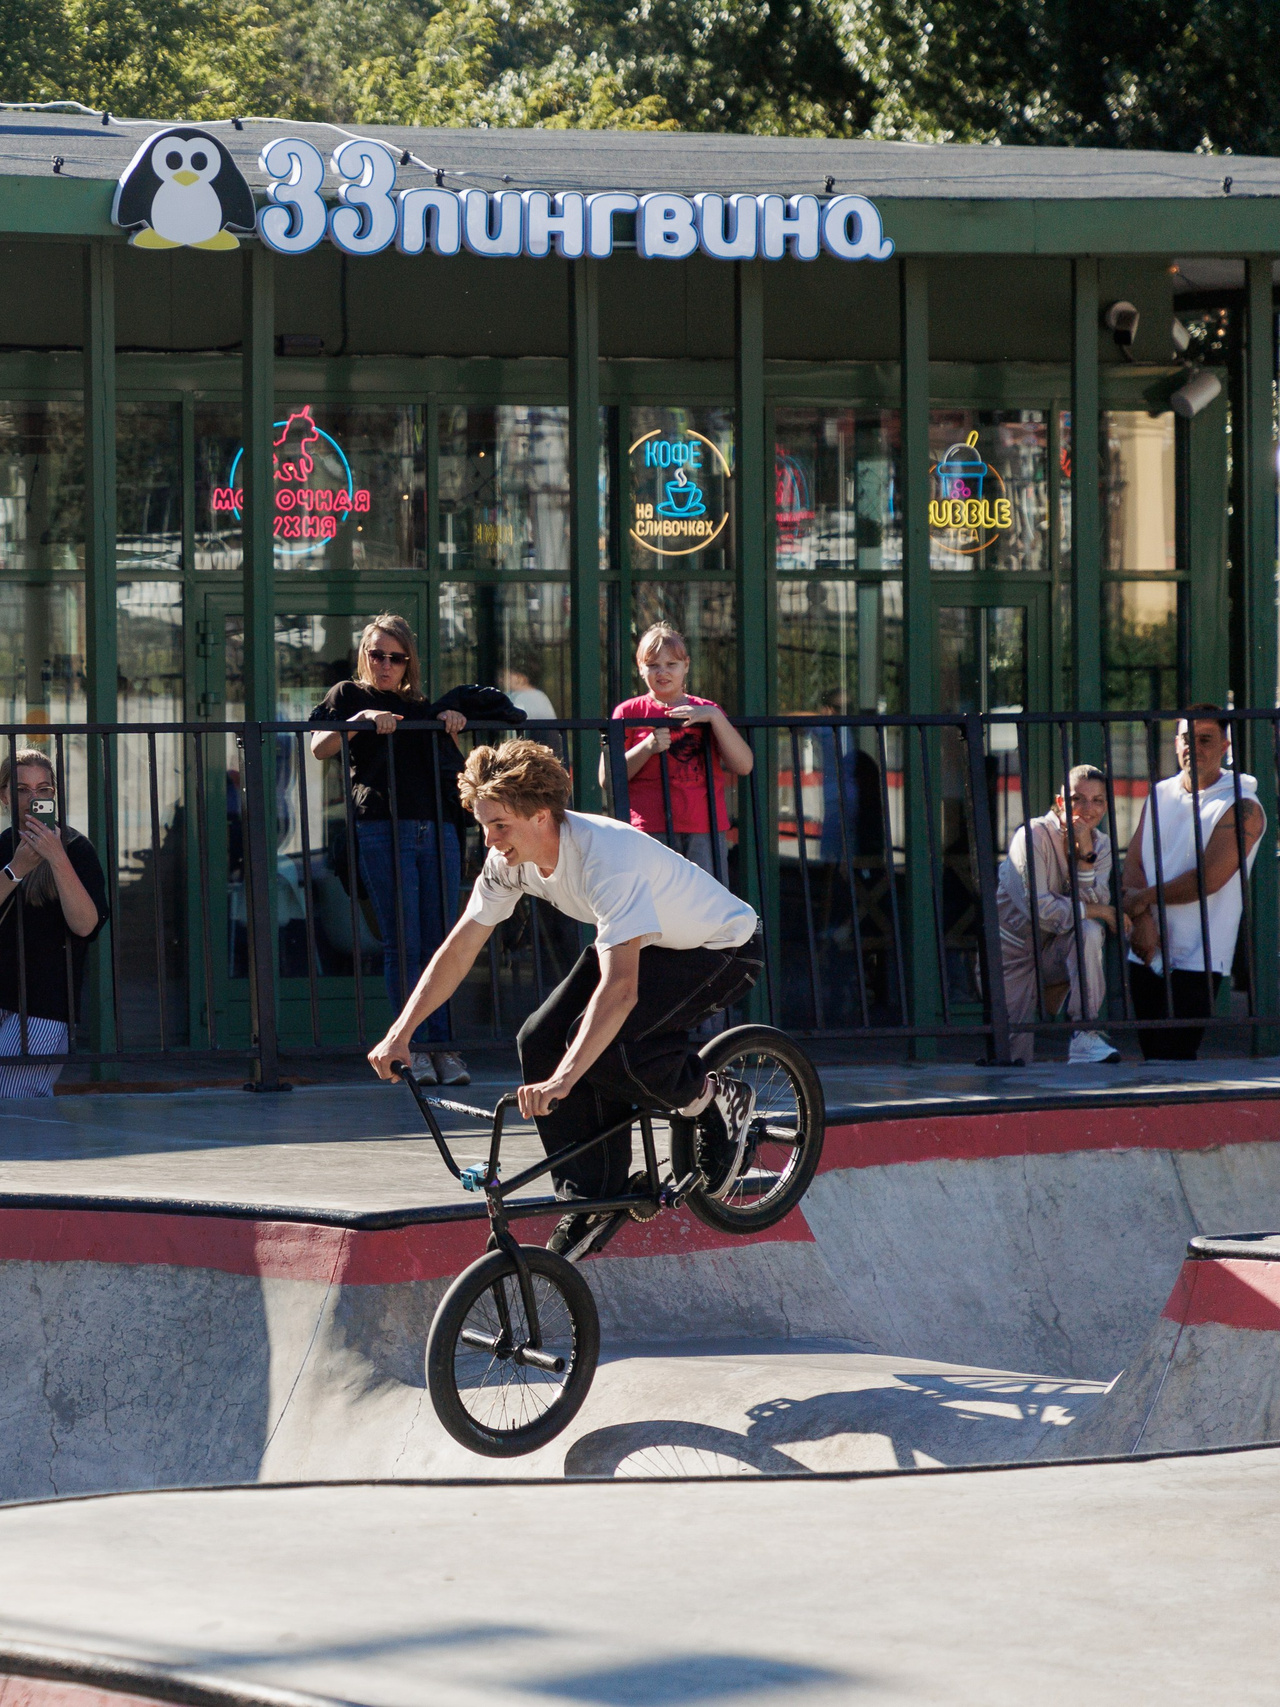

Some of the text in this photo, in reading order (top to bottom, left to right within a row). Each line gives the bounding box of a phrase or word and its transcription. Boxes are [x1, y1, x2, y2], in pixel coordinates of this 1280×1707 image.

[644, 440, 703, 469] КОФЕ
[928, 499, 1012, 528] UBBLE
[946, 528, 979, 543] TEA
